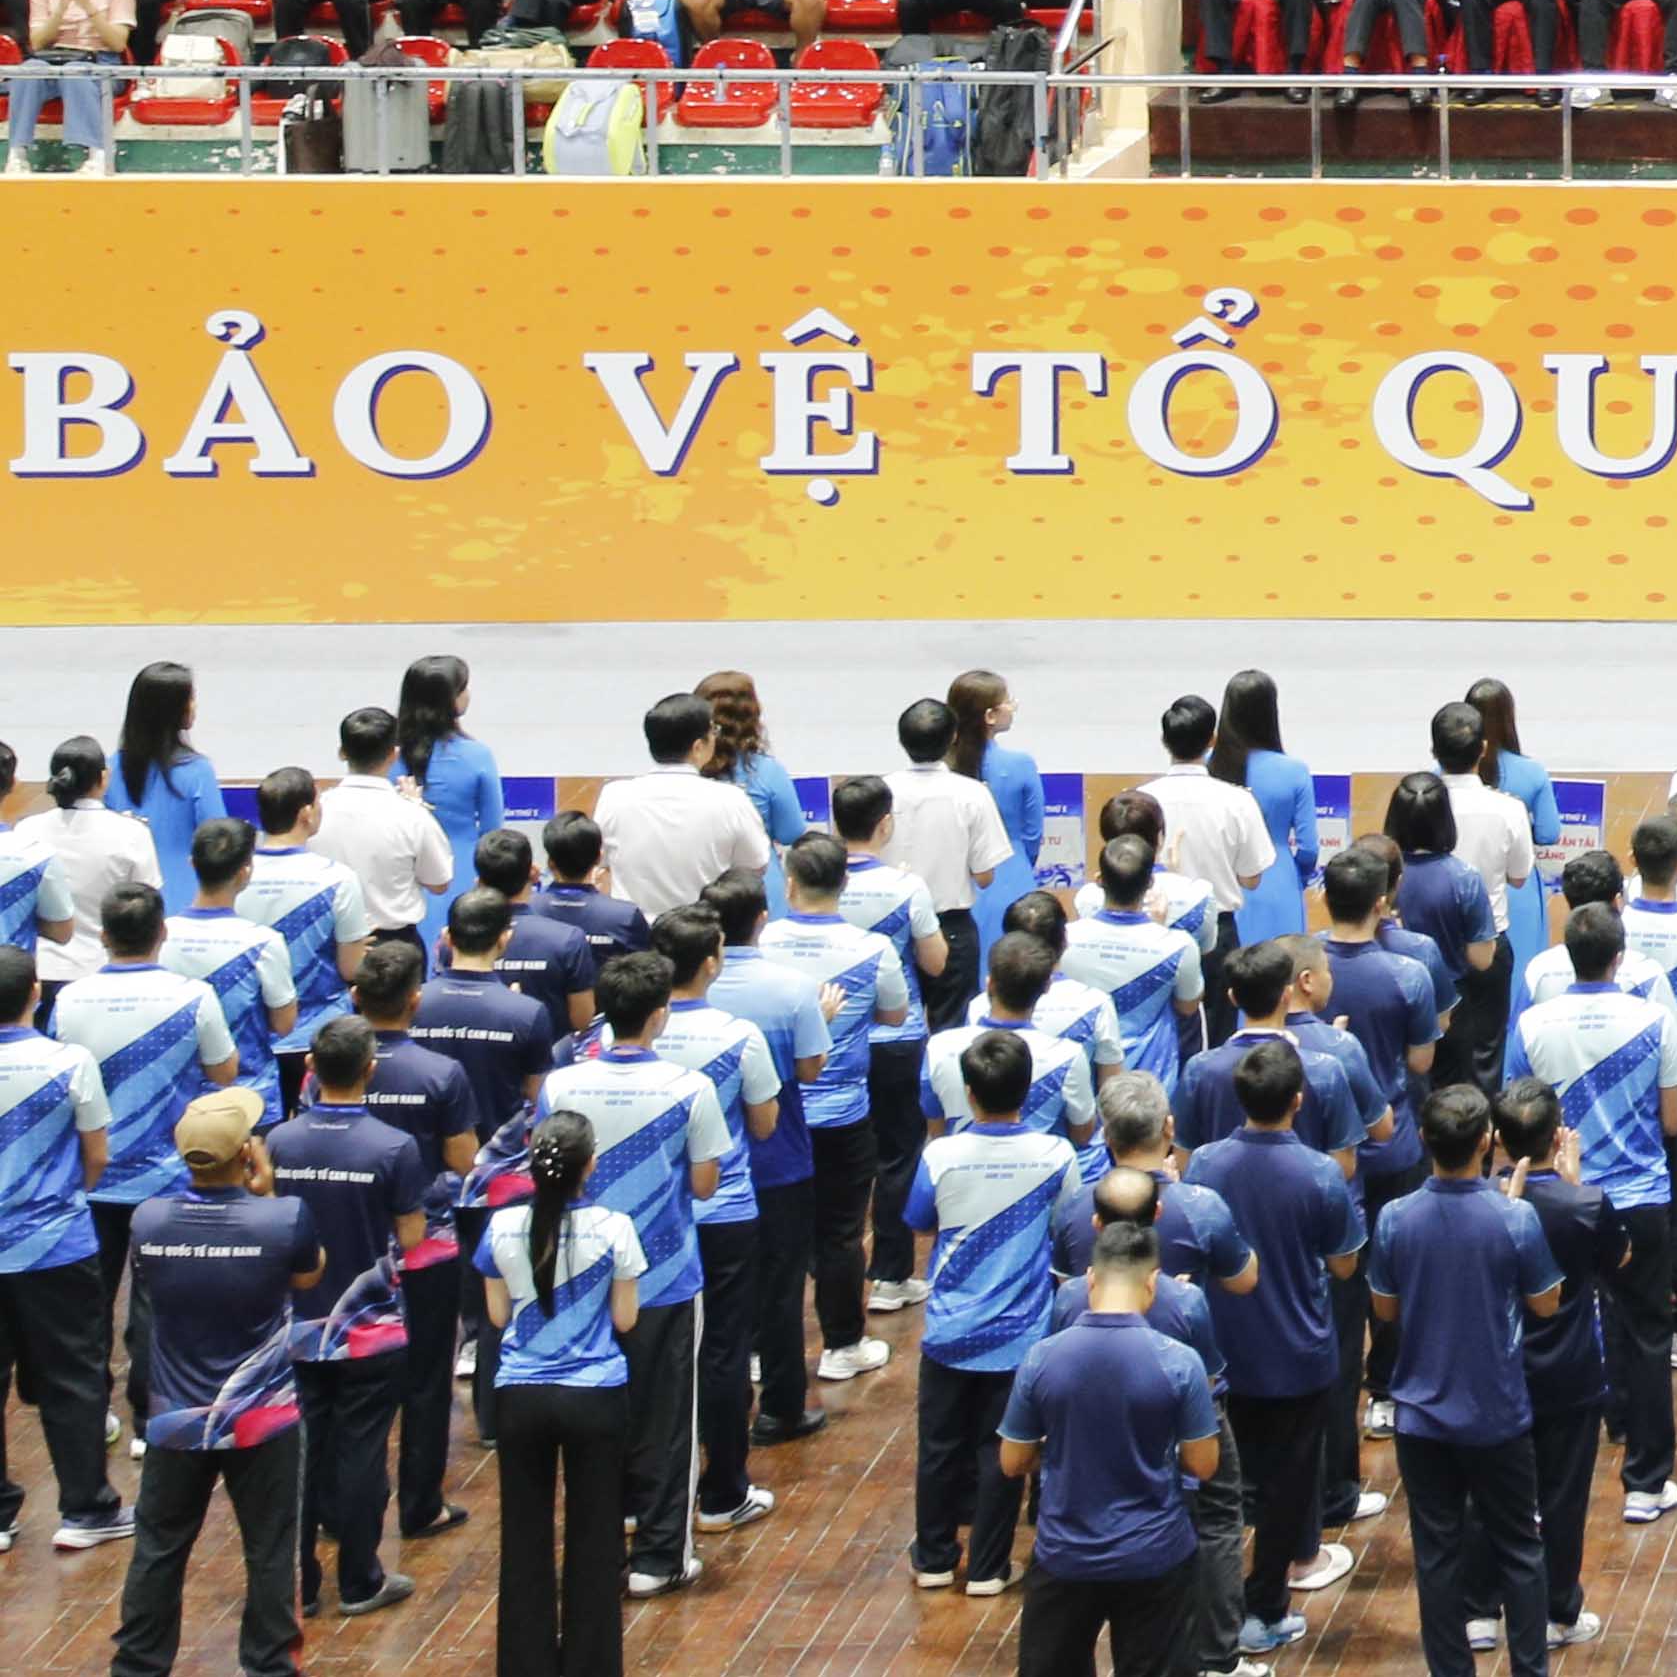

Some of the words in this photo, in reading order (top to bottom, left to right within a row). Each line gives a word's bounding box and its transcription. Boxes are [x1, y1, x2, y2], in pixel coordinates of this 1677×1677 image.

[6, 309, 493, 479] BẢO
[583, 306, 884, 504] VỆ
[972, 287, 1281, 479] TỔ
